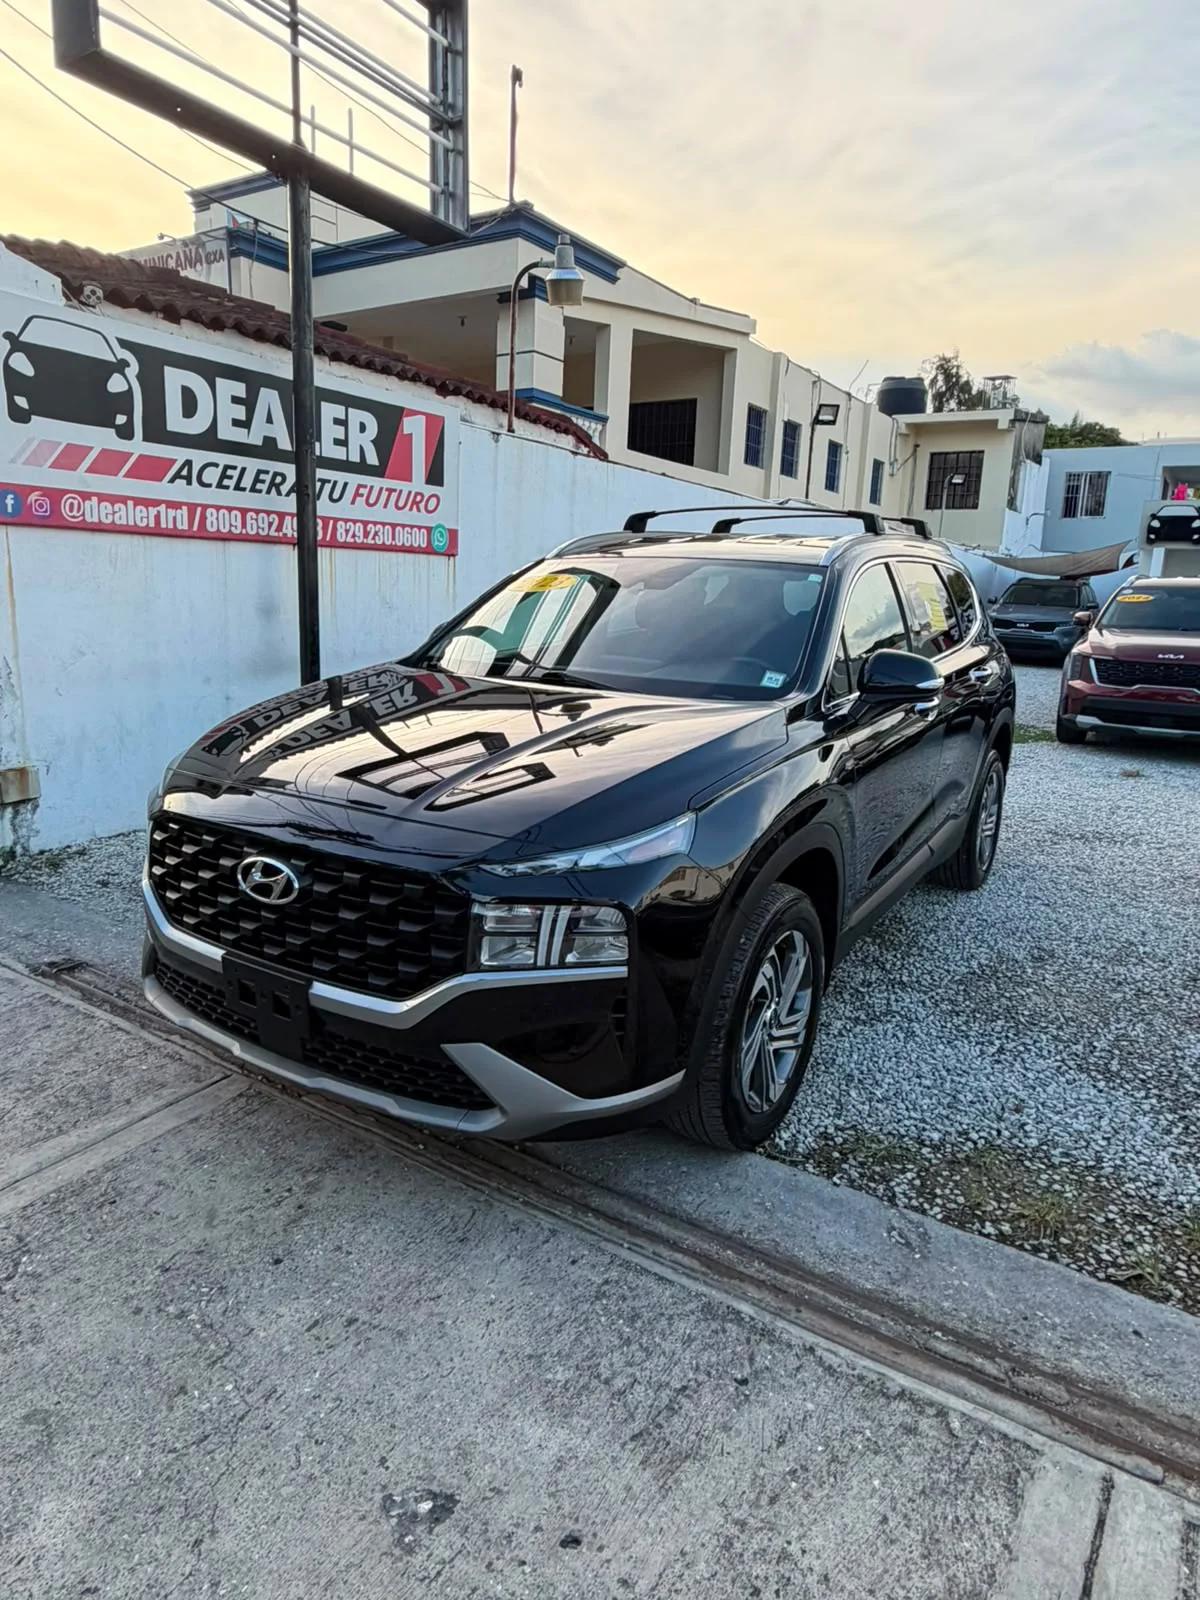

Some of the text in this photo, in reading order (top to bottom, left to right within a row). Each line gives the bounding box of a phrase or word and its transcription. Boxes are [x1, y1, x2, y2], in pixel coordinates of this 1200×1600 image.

[163, 365, 427, 485] DEAER 1
[60, 494, 188, 529] @dealer1rd
[192, 507, 201, 531] /
[205, 507, 323, 541] 809.692.4
[326, 519, 333, 541] /
[336, 520, 427, 547] 829.230.0600
[316, 477, 349, 504] TU
[350, 483, 441, 515] FUTURO
